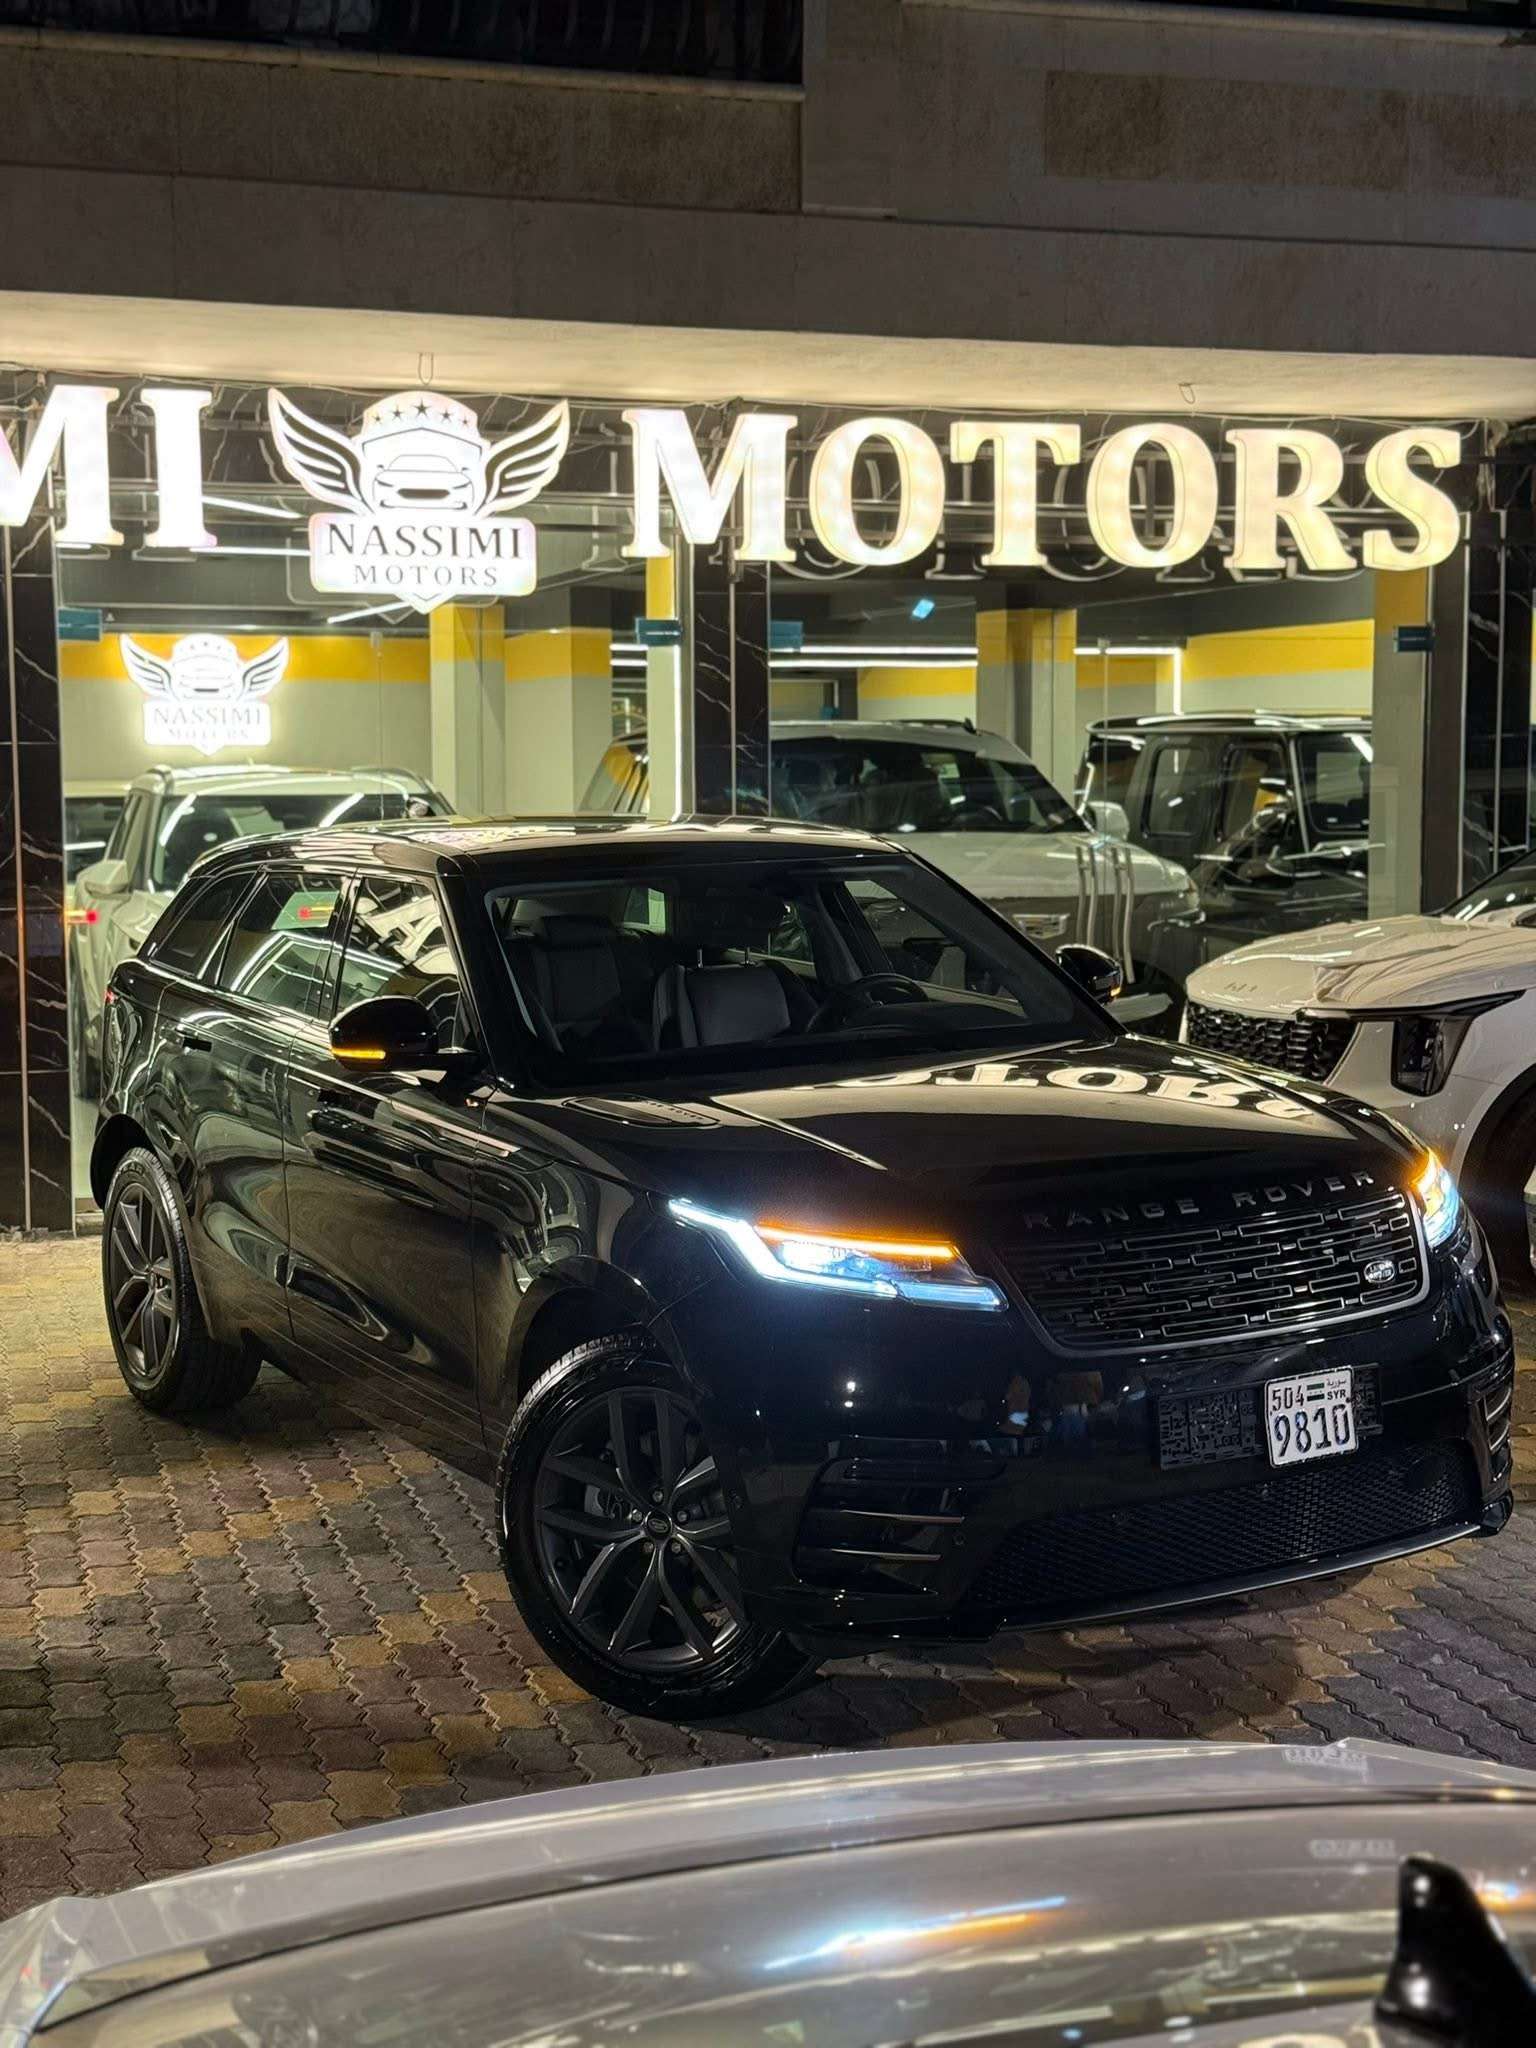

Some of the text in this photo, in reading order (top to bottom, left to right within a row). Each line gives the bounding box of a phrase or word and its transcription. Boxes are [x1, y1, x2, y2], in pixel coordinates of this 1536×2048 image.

[621, 409, 1462, 571] MOTORS
[327, 522, 523, 559] NASSIMI
[354, 564, 498, 587] MOTORS
[153, 707, 262, 725] NASSIMI
[1022, 1170, 1375, 1230] RANGE ROVER
[1271, 1384, 1305, 1412] 504
[1326, 1388, 1347, 1401] SYR
[1273, 1403, 1351, 1458] 9810
